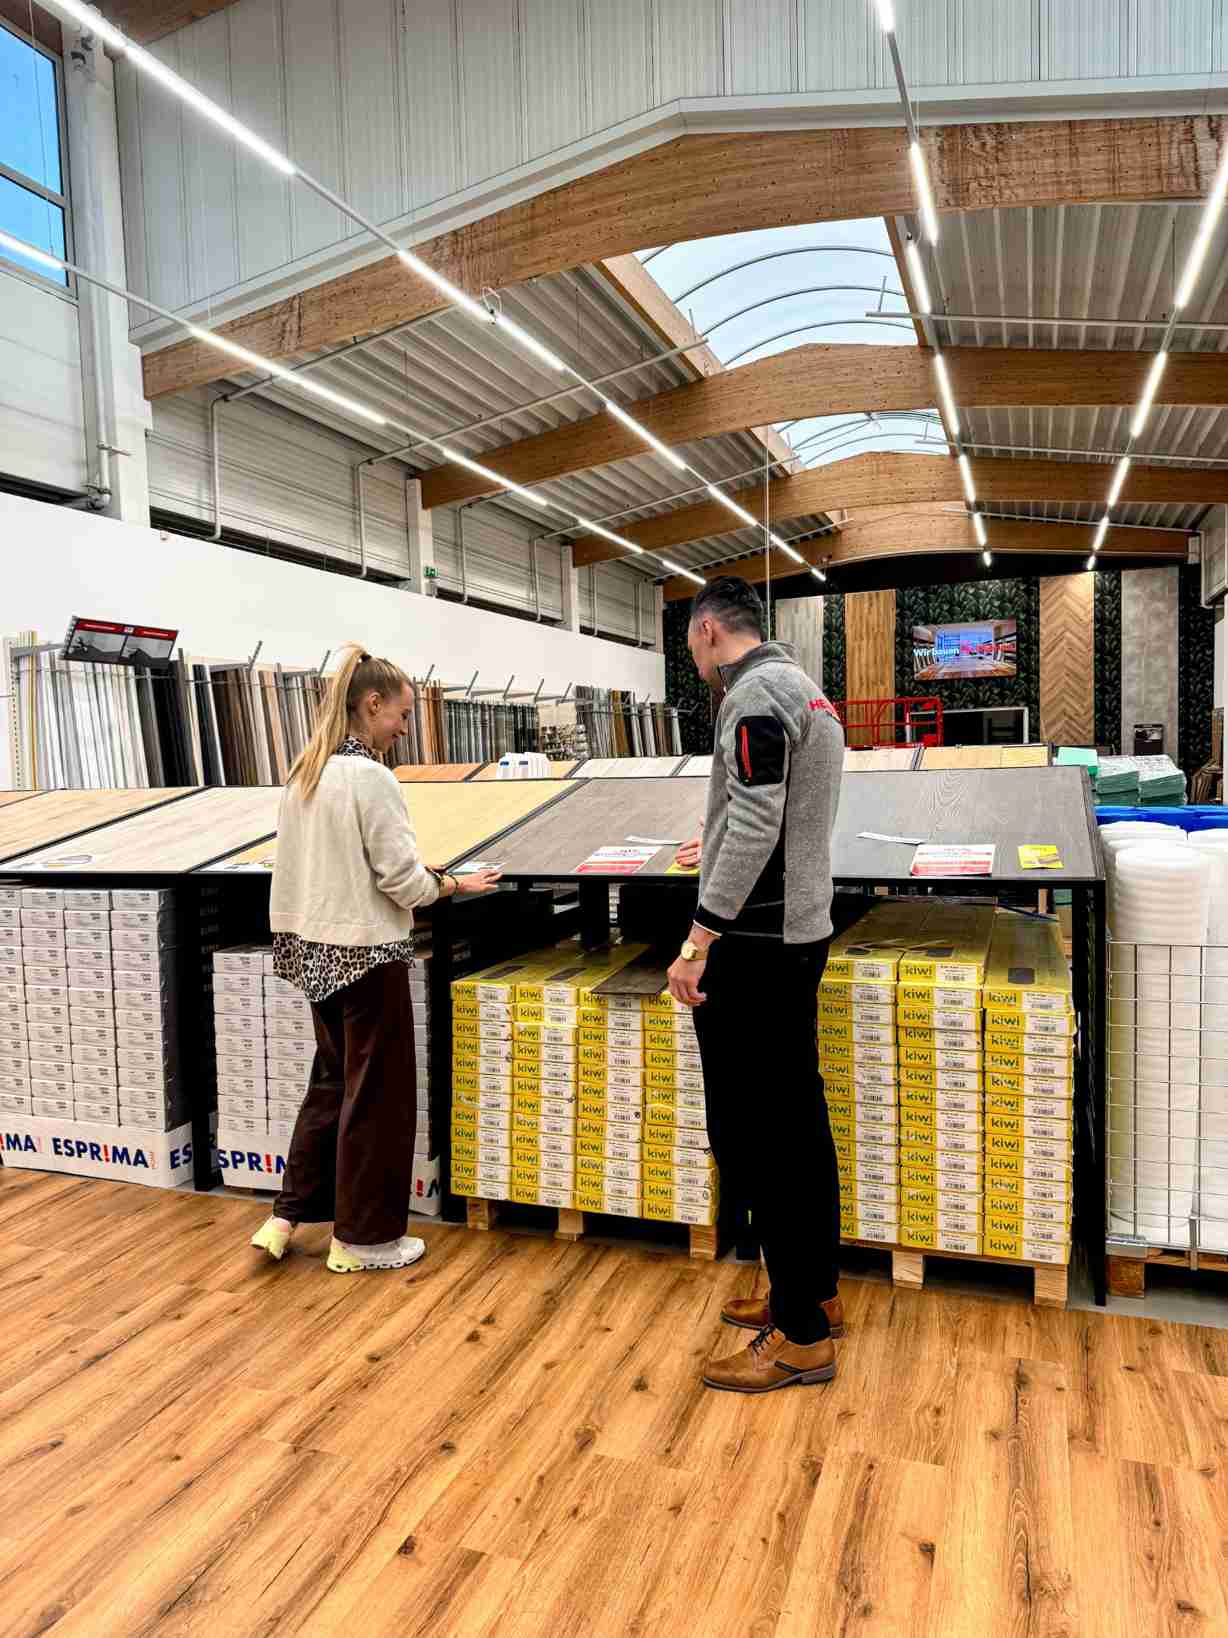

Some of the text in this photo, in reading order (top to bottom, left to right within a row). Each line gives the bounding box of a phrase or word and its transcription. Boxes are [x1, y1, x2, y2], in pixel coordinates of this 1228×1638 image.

[905, 965, 931, 975] kiwi
[904, 988, 930, 998] kiwi
[989, 992, 1016, 1002] kiwi
[904, 1009, 930, 1019] kiwi
[992, 1014, 1019, 1025] kiwi
[905, 1027, 932, 1038] kiwi
[992, 1035, 1019, 1046] kiwi
[906, 1048, 932, 1060] kiwi
[992, 1056, 1019, 1067] kiwi
[906, 1070, 933, 1081] kiwi
[992, 1075, 1019, 1087] kiwi
[906, 1091, 933, 1100] kiwi
[992, 1096, 1019, 1108] kiwi
[906, 1112, 933, 1122] kiwi
[992, 1118, 1019, 1128] kiwi
[833, 1125, 850, 1133] iwi
[907, 1131, 933, 1140] kiwi
[992, 1137, 1019, 1149] kiwi
[52, 1137, 149, 1168] ESPR!MA
[908, 1151, 934, 1161] kiwi
[991, 1158, 1017, 1169] kiwi
[908, 1171, 934, 1182] kiwi
[908, 1191, 934, 1201] kiwi
[992, 1200, 1017, 1211] kiwi
[908, 1210, 933, 1221] kiwi
[992, 1220, 1017, 1231] kiwi
[908, 1230, 933, 1241] kiwi
[991, 1239, 1016, 1251] kiwi
